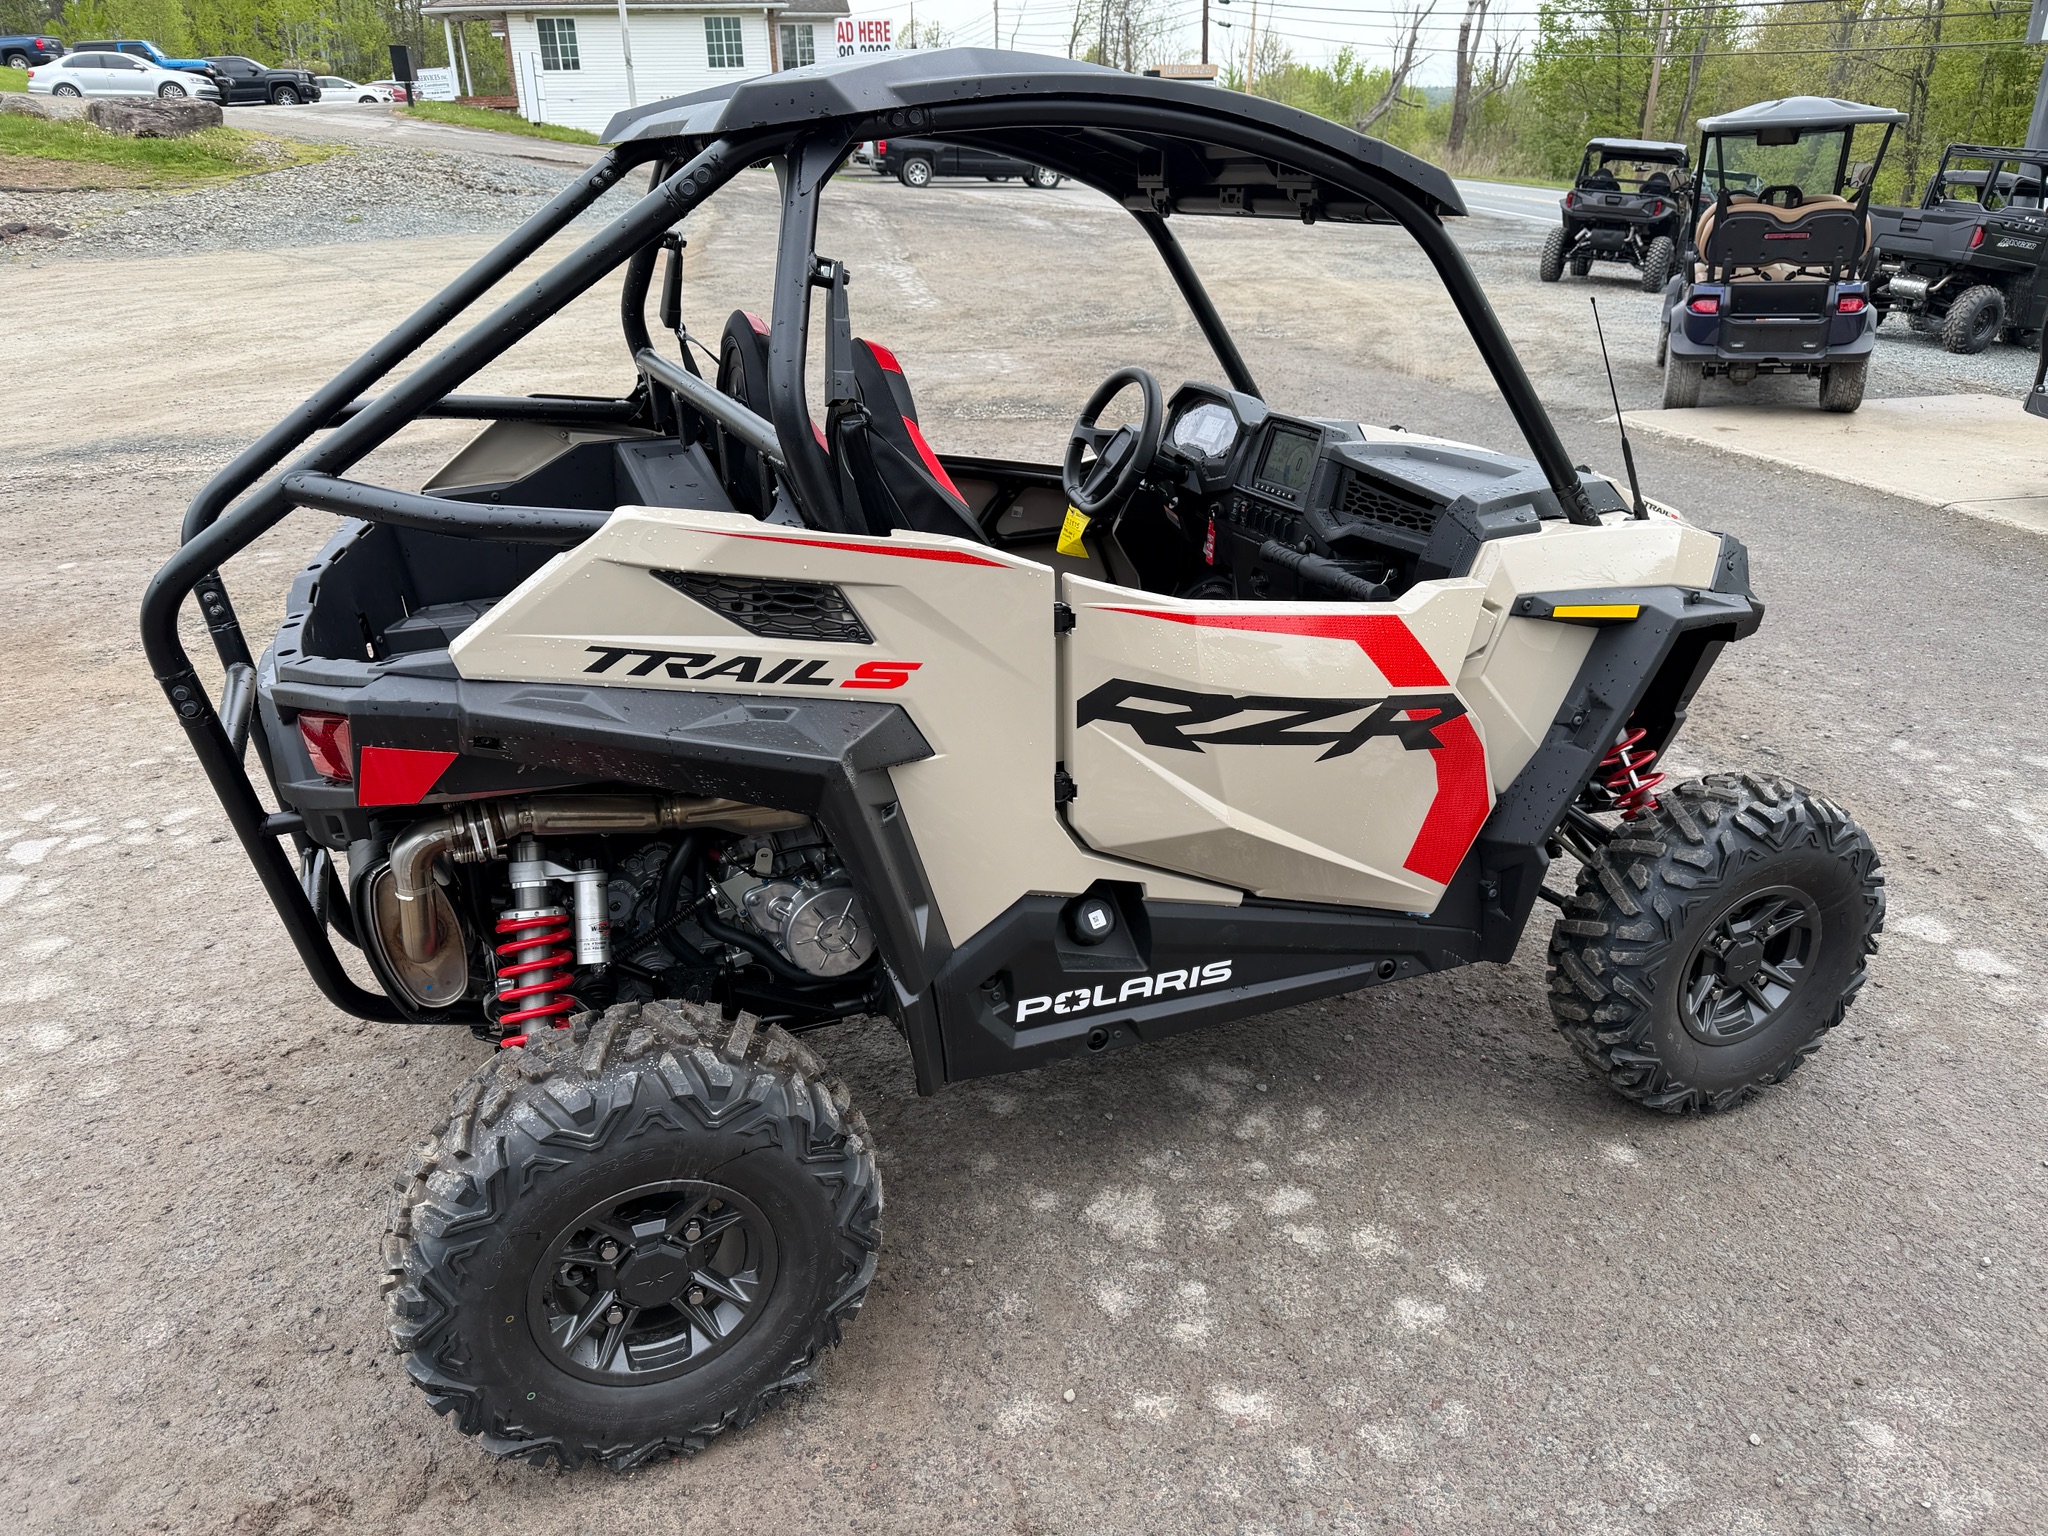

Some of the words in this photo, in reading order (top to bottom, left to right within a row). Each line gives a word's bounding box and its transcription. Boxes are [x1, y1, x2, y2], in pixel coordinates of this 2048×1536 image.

[837, 21, 854, 43] AD
[858, 21, 891, 42] HERE
[1182, 66, 1212, 75] PLAZA
[1644, 501, 1670, 517] TRAIL
[584, 645, 834, 687] TRAIL
[839, 661, 923, 690] S
[1077, 678, 1468, 763] RZR
[1015, 959, 1233, 1023] POLARIS
